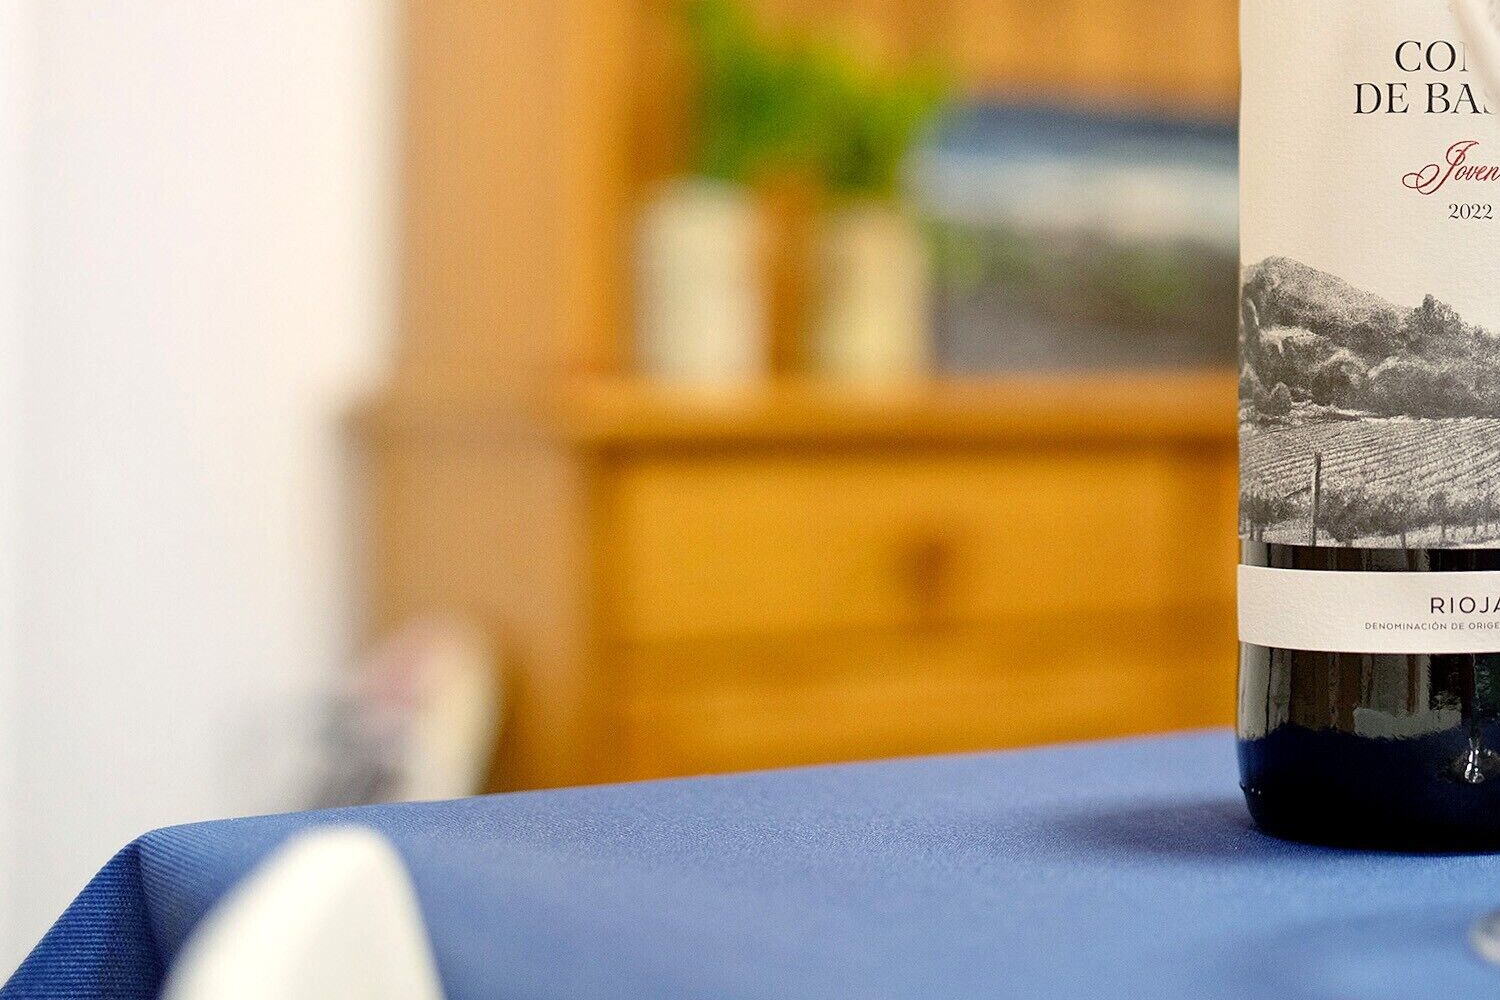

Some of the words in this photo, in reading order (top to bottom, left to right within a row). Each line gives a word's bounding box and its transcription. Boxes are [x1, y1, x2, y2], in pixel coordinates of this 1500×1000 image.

[1353, 82, 1410, 115] DE
[1423, 82, 1497, 116] BA
[1448, 203, 1494, 220] 2022
[1364, 621, 1447, 631] DENOMINACIÓN
[1451, 622, 1465, 630] DE
